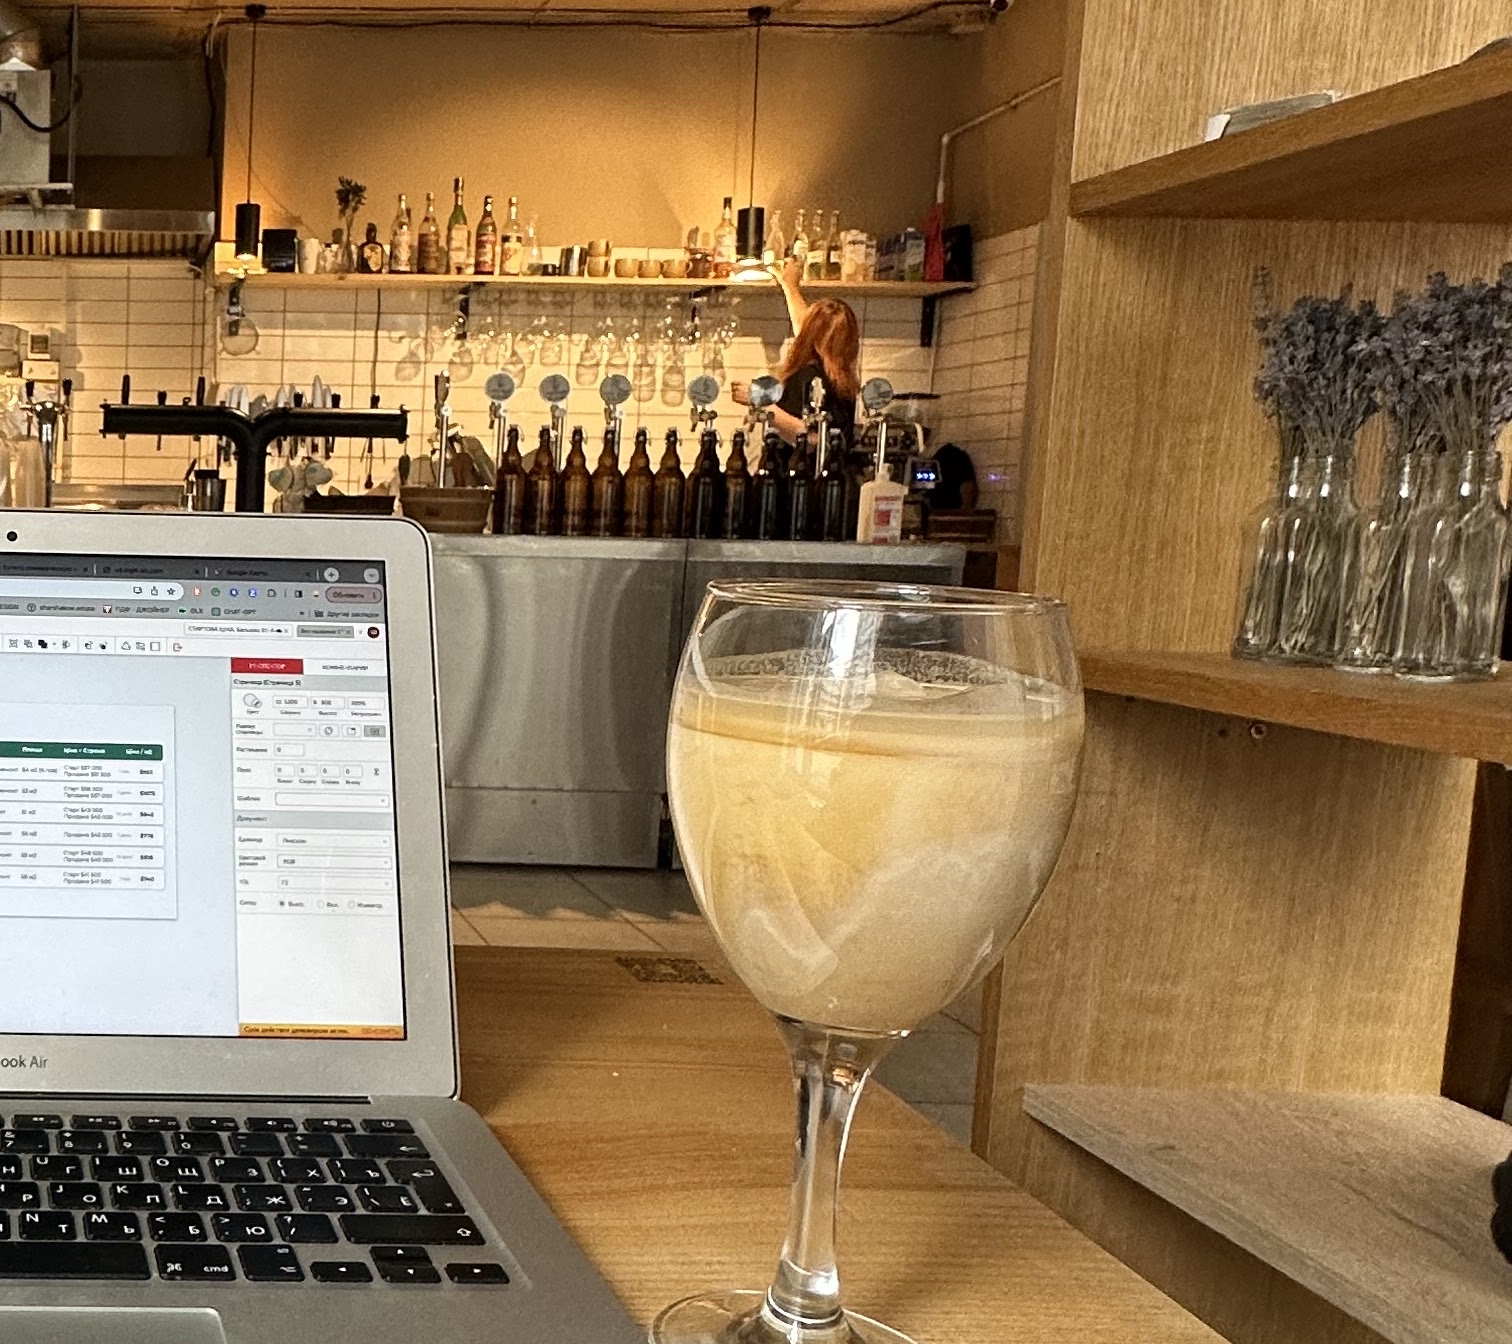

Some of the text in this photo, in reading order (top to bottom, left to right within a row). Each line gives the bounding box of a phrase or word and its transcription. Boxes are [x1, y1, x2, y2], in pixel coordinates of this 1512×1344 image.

[30, 1056, 48, 1068] Air
[178, 1186, 187, 1194] L
[26, 1214, 39, 1222] N
[92, 1214, 108, 1223] M
[246, 1227, 265, 1235] Ю
